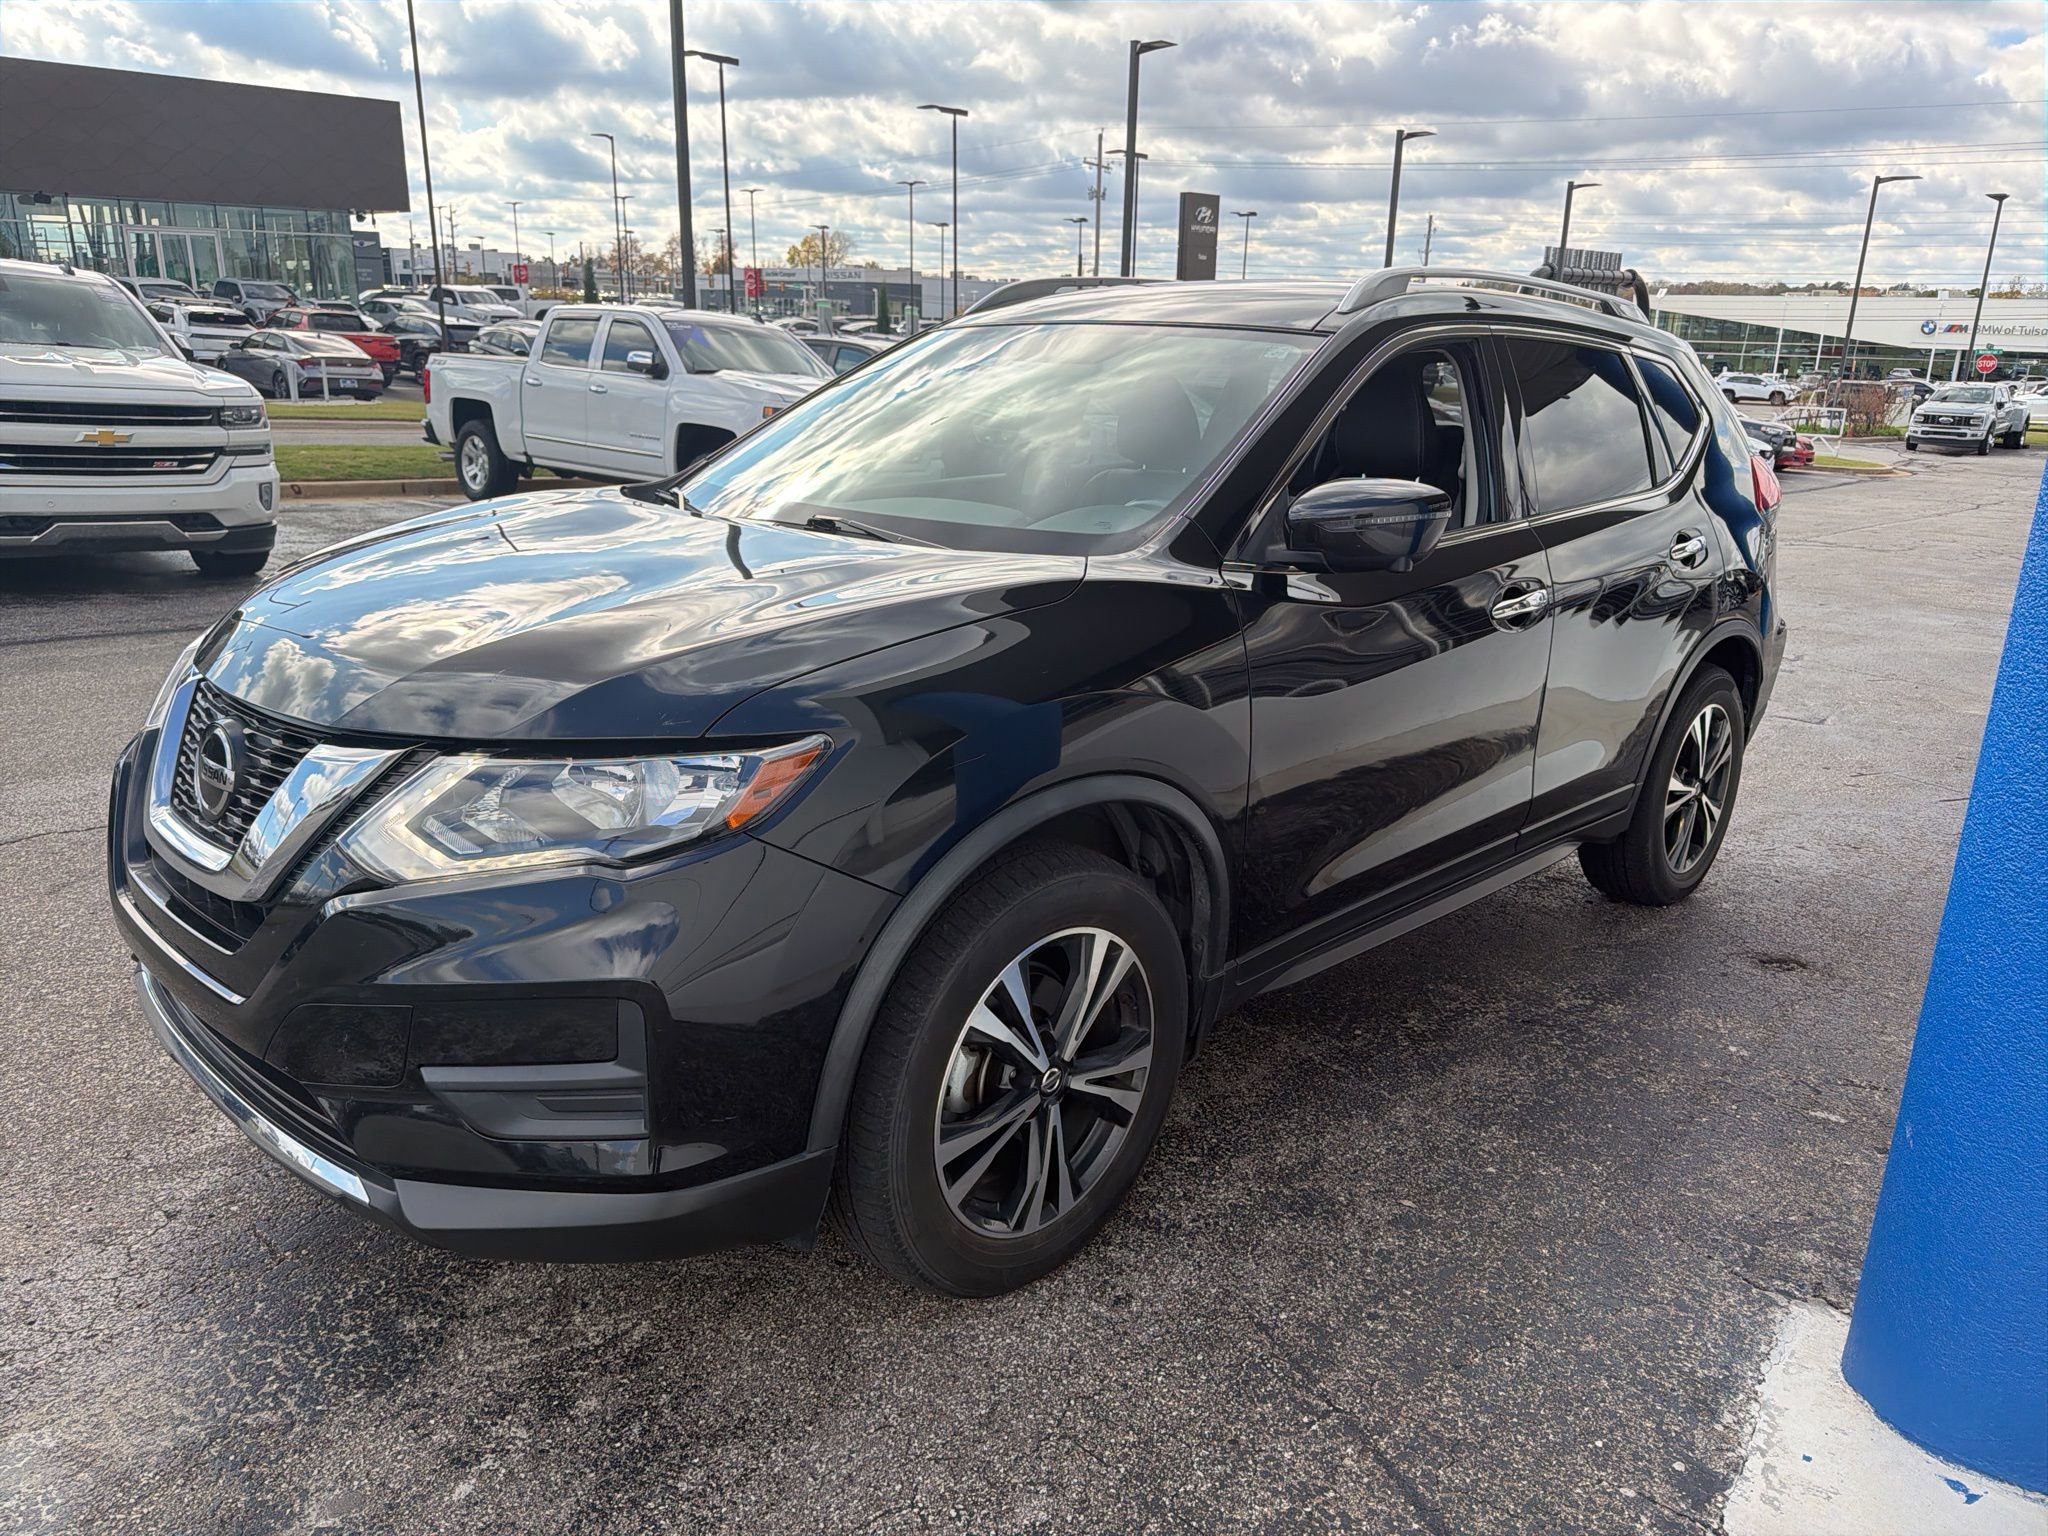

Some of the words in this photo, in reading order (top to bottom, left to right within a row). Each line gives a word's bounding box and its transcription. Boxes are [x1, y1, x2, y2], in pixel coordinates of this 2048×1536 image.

[825, 271, 862, 279] NISSAN
[2004, 325, 2017, 336] of
[2018, 325, 2048, 336] Tulsa
[1977, 360, 1996, 368] STOP
